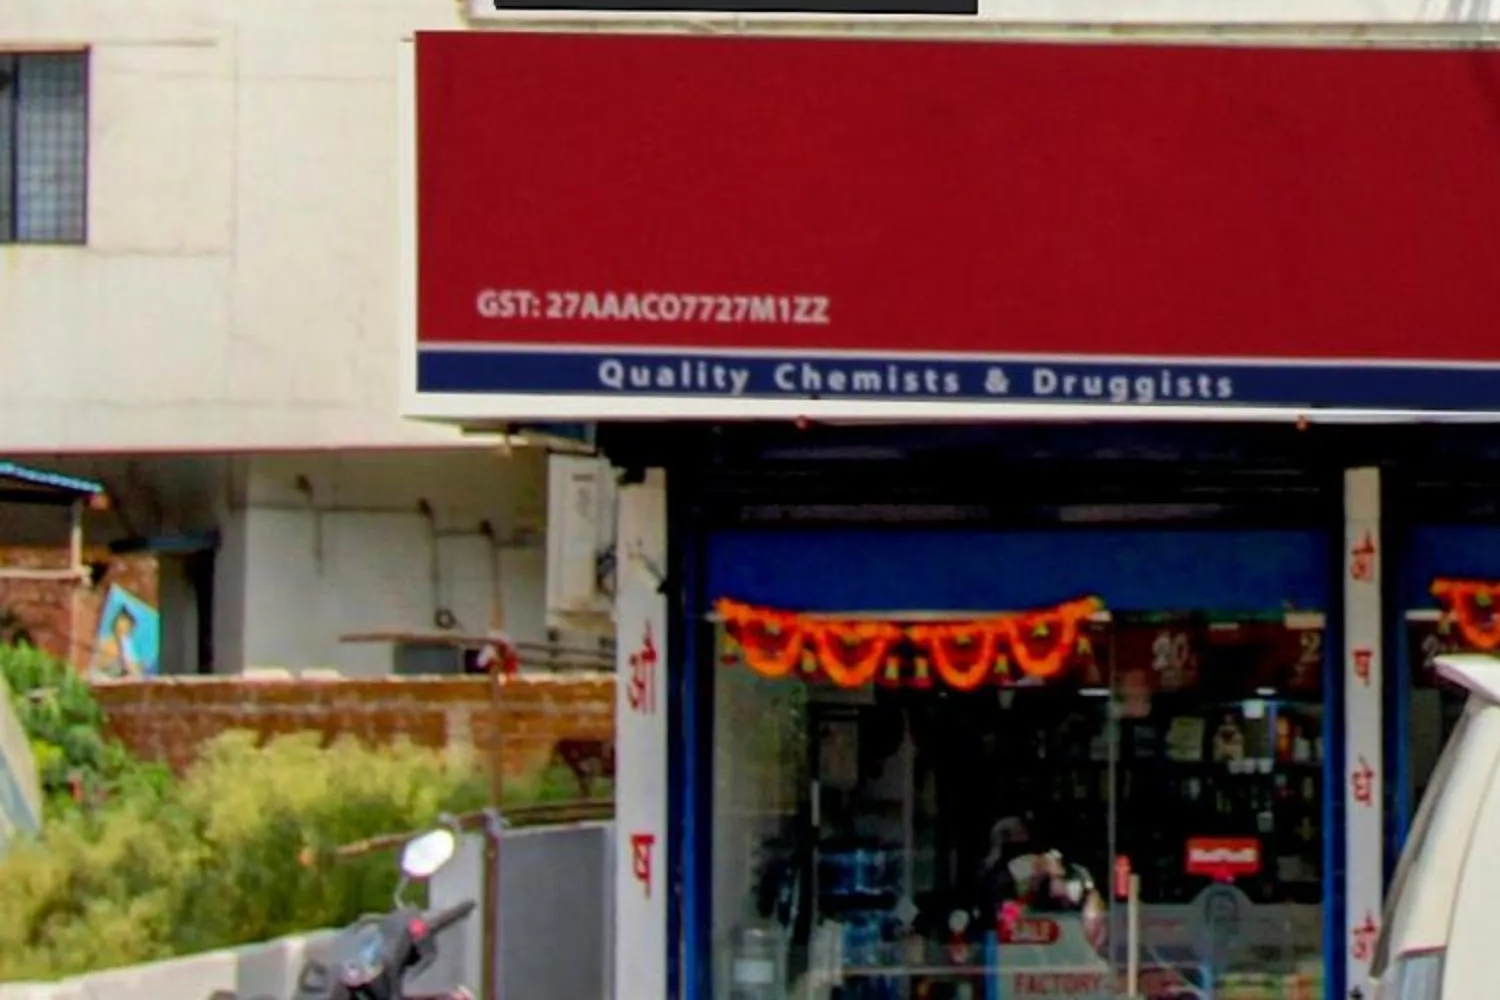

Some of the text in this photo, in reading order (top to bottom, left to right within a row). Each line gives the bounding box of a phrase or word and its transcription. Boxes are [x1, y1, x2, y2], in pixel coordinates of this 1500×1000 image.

[476, 289, 541, 320] GST:
[598, 358, 1234, 402] Quality Chemists & Druggists
